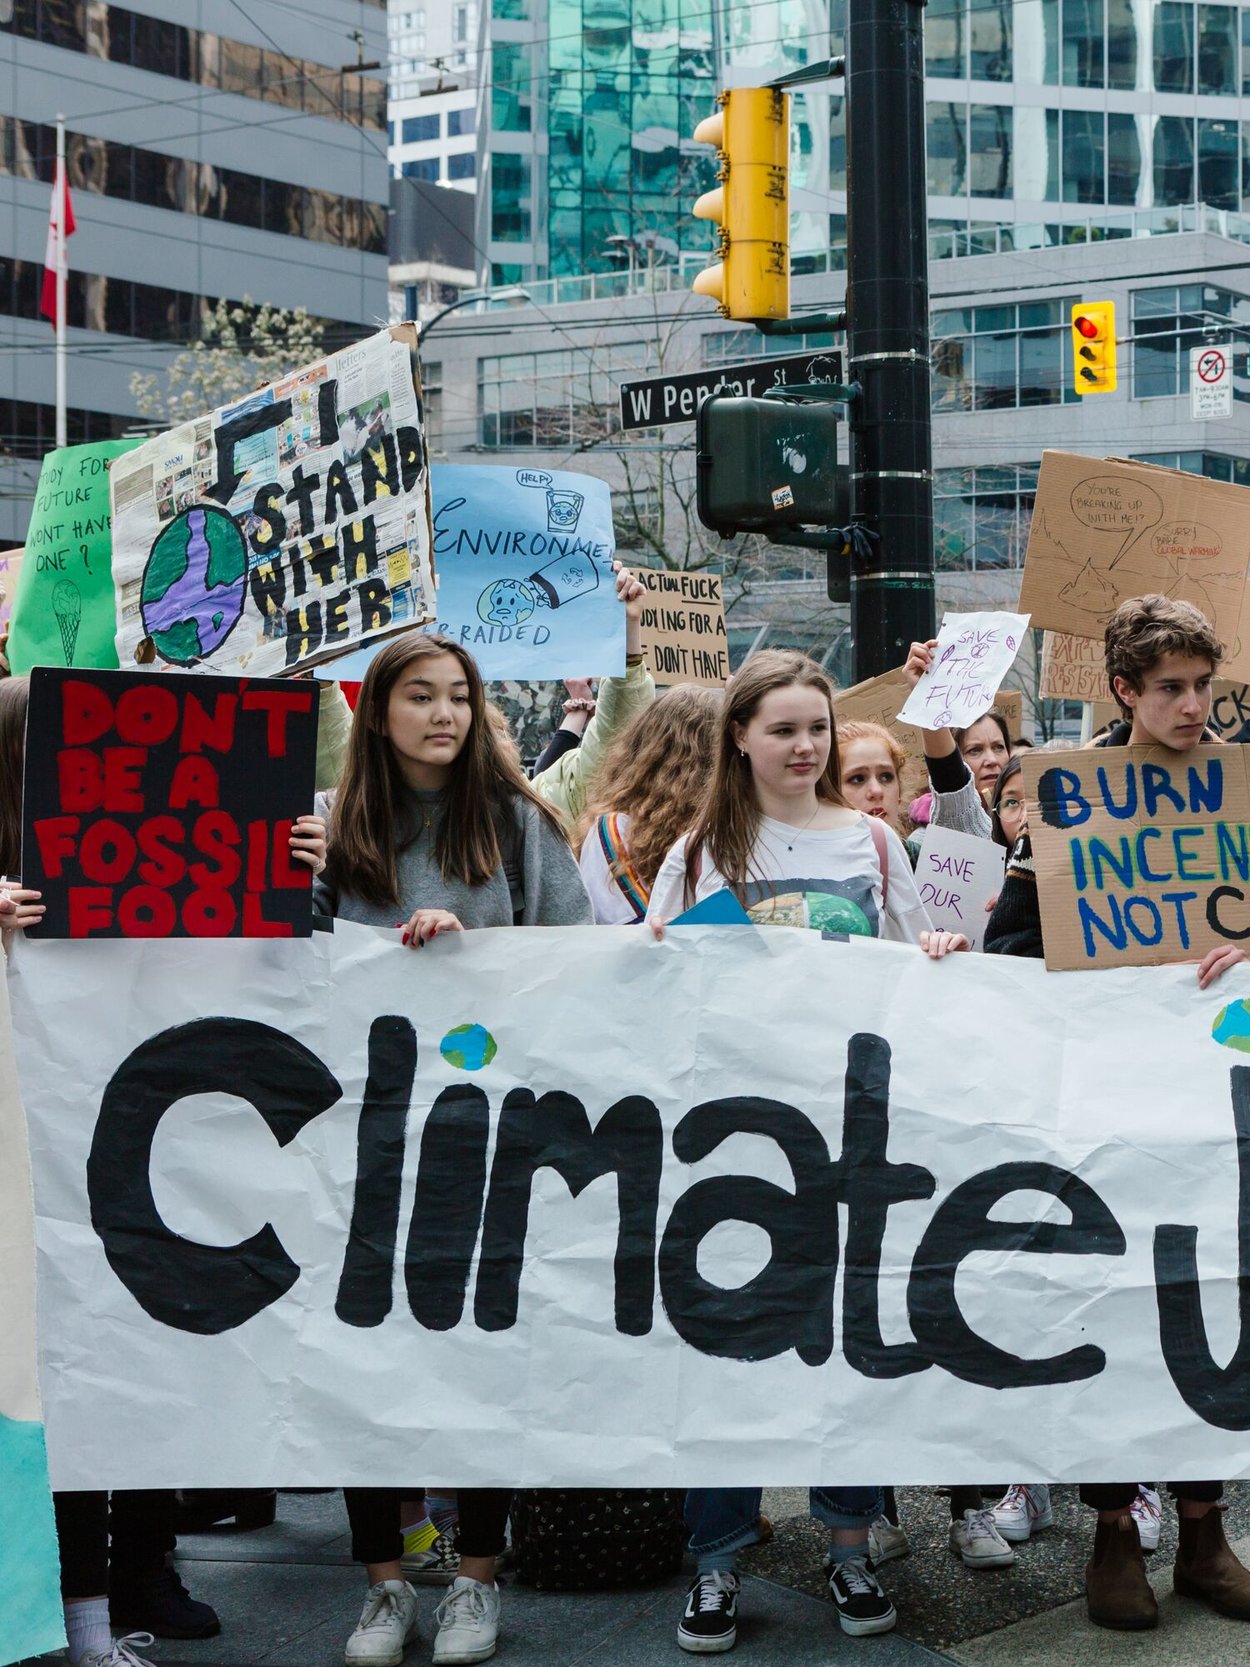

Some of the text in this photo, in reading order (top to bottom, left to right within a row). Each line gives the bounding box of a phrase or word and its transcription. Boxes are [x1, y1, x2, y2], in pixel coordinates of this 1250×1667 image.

[630, 389, 651, 422] W
[774, 368, 787, 386] St
[80, 457, 110, 476] FOR
[37, 487, 93, 512] FUTURE
[1076, 499, 1143, 511] BREAKING UP
[1087, 482, 1121, 497] YOU'RE
[73, 514, 112, 539] HAVE
[1088, 512, 1117, 524] WITH
[36, 549, 70, 572] ONE
[250, 514, 379, 618] WITH
[681, 576, 721, 600] FUCK
[284, 577, 393, 667] HER
[689, 611, 714, 635] FOR
[716, 615, 727, 637] A
[957, 628, 1000, 644] SAVE
[654, 643, 688, 675] DON'T
[691, 649, 728, 681] HAVE
[61, 677, 312, 758] DON'T
[57, 746, 220, 813] BE A
[1038, 758, 1223, 829] BURN
[33, 810, 312, 893] FOSSIL
[929, 854, 975, 882] SAVE
[68, 885, 293, 938] FOOL
[919, 883, 963, 919] OUR
[1078, 891, 1198, 957] NOT
[87, 1014, 1127, 1391] Climate
